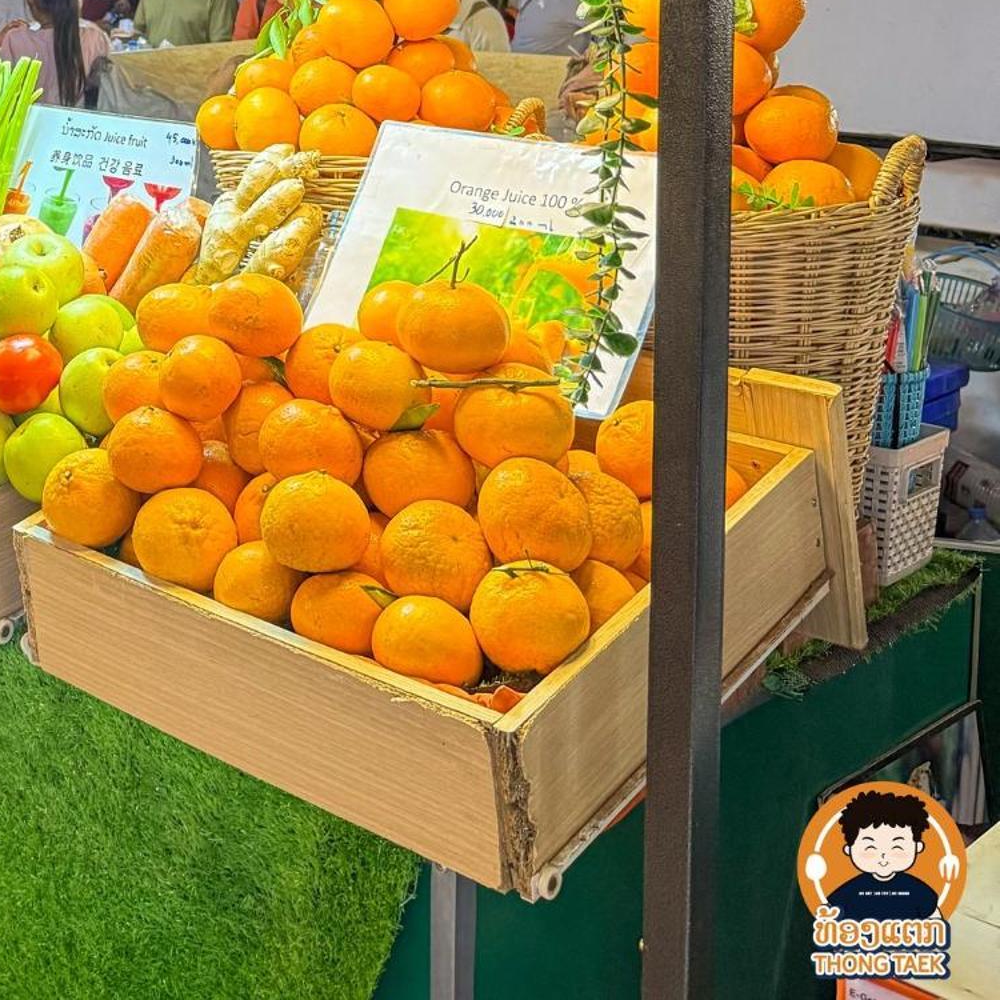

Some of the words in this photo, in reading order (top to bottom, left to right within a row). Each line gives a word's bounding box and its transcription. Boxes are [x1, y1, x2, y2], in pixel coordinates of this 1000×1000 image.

[103, 131, 126, 145] Juice
[127, 133, 148, 149] fruit
[98, 156, 121, 174] 건강
[121, 160, 144, 177] 음료
[450, 180, 500, 202] Orange
[502, 188, 537, 206] Juice
[539, 193, 568, 209] 100
